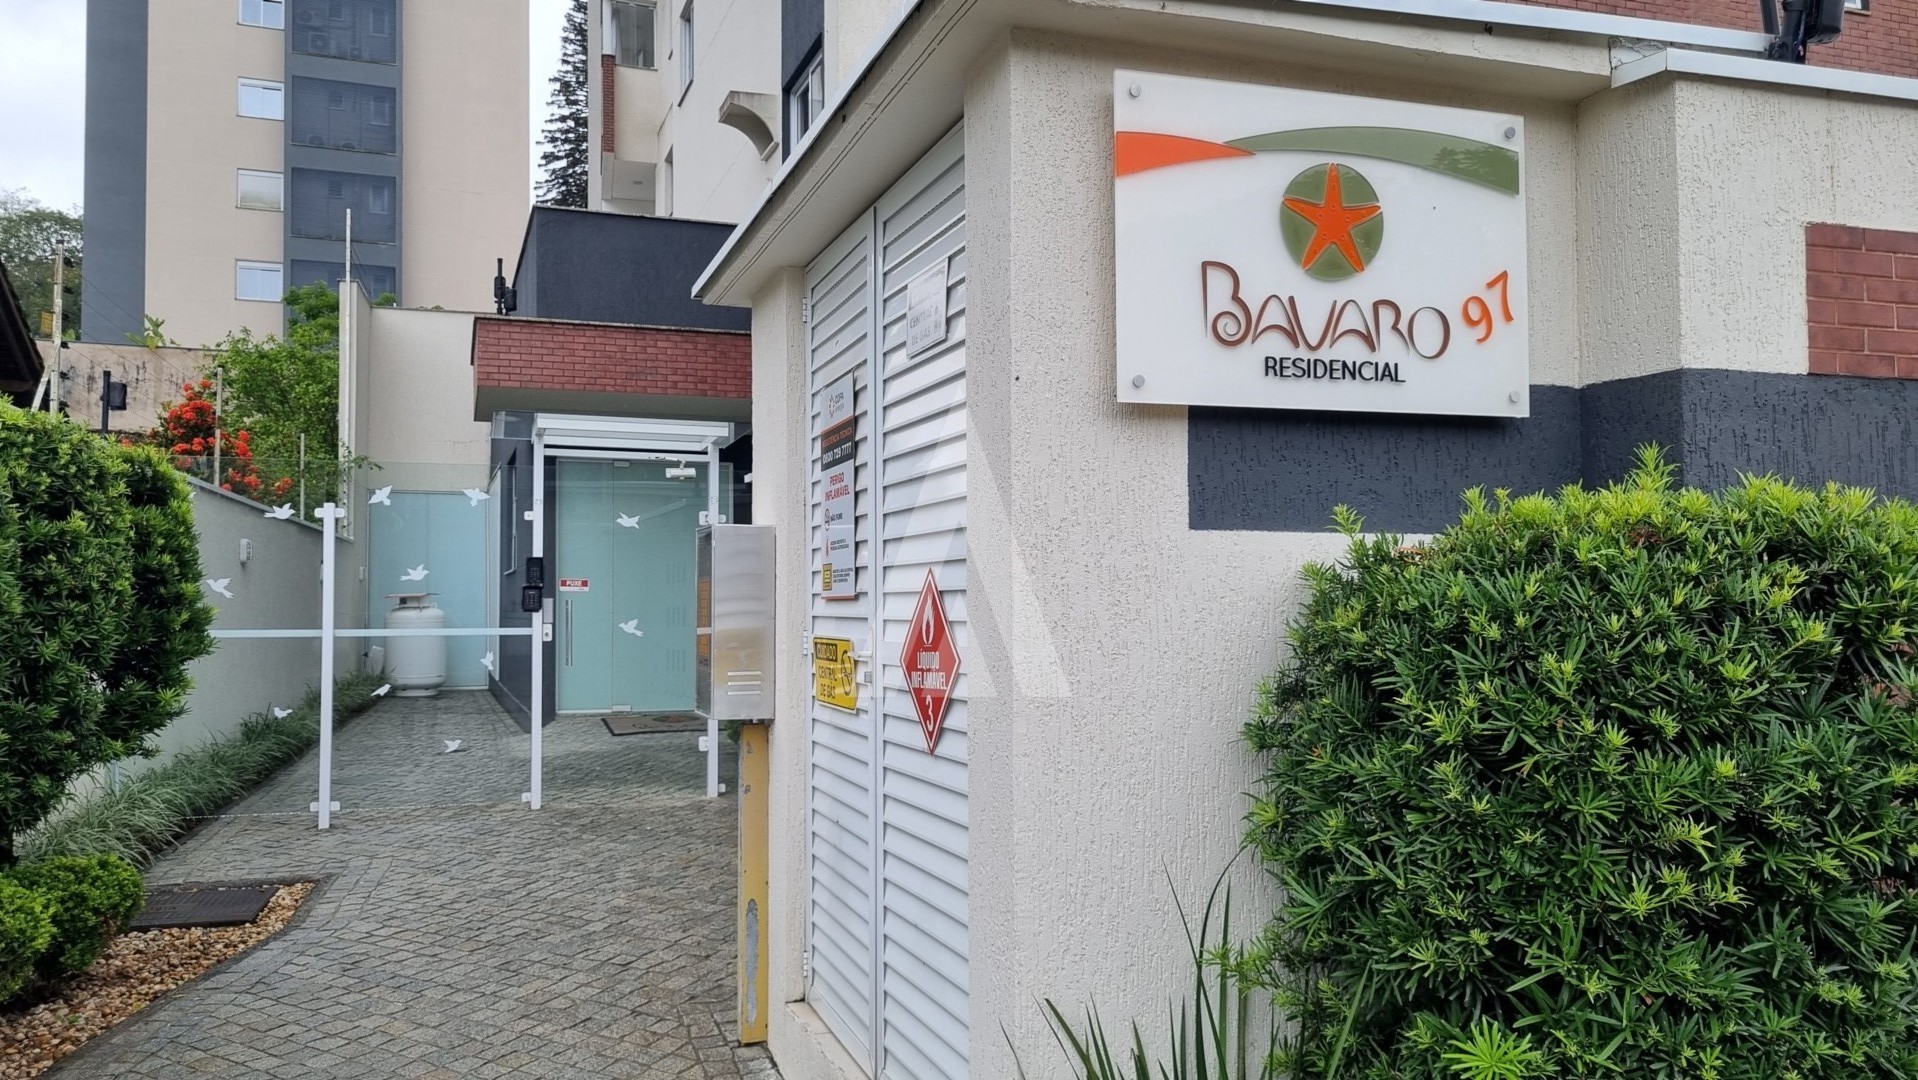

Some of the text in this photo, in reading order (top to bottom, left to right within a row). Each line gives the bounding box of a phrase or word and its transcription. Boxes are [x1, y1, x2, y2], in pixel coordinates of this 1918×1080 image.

[1201, 260, 1515, 360] BAVARO 97
[1264, 355, 1407, 384] RESIDENCIAL
[822, 450, 833, 465] 0800
[841, 441, 852, 456] 7777
[829, 471, 845, 486] PERIGO
[824, 483, 850, 502] INFLAMÁVEL
[816, 643, 837, 660] CUIDADO
[917, 648, 940, 672] LÍQUIDO
[818, 665, 838, 681] CENTRAL
[911, 668, 948, 691] INFLAMÁVEL
[820, 683, 826, 697] DE
[925, 694, 934, 732] 3
